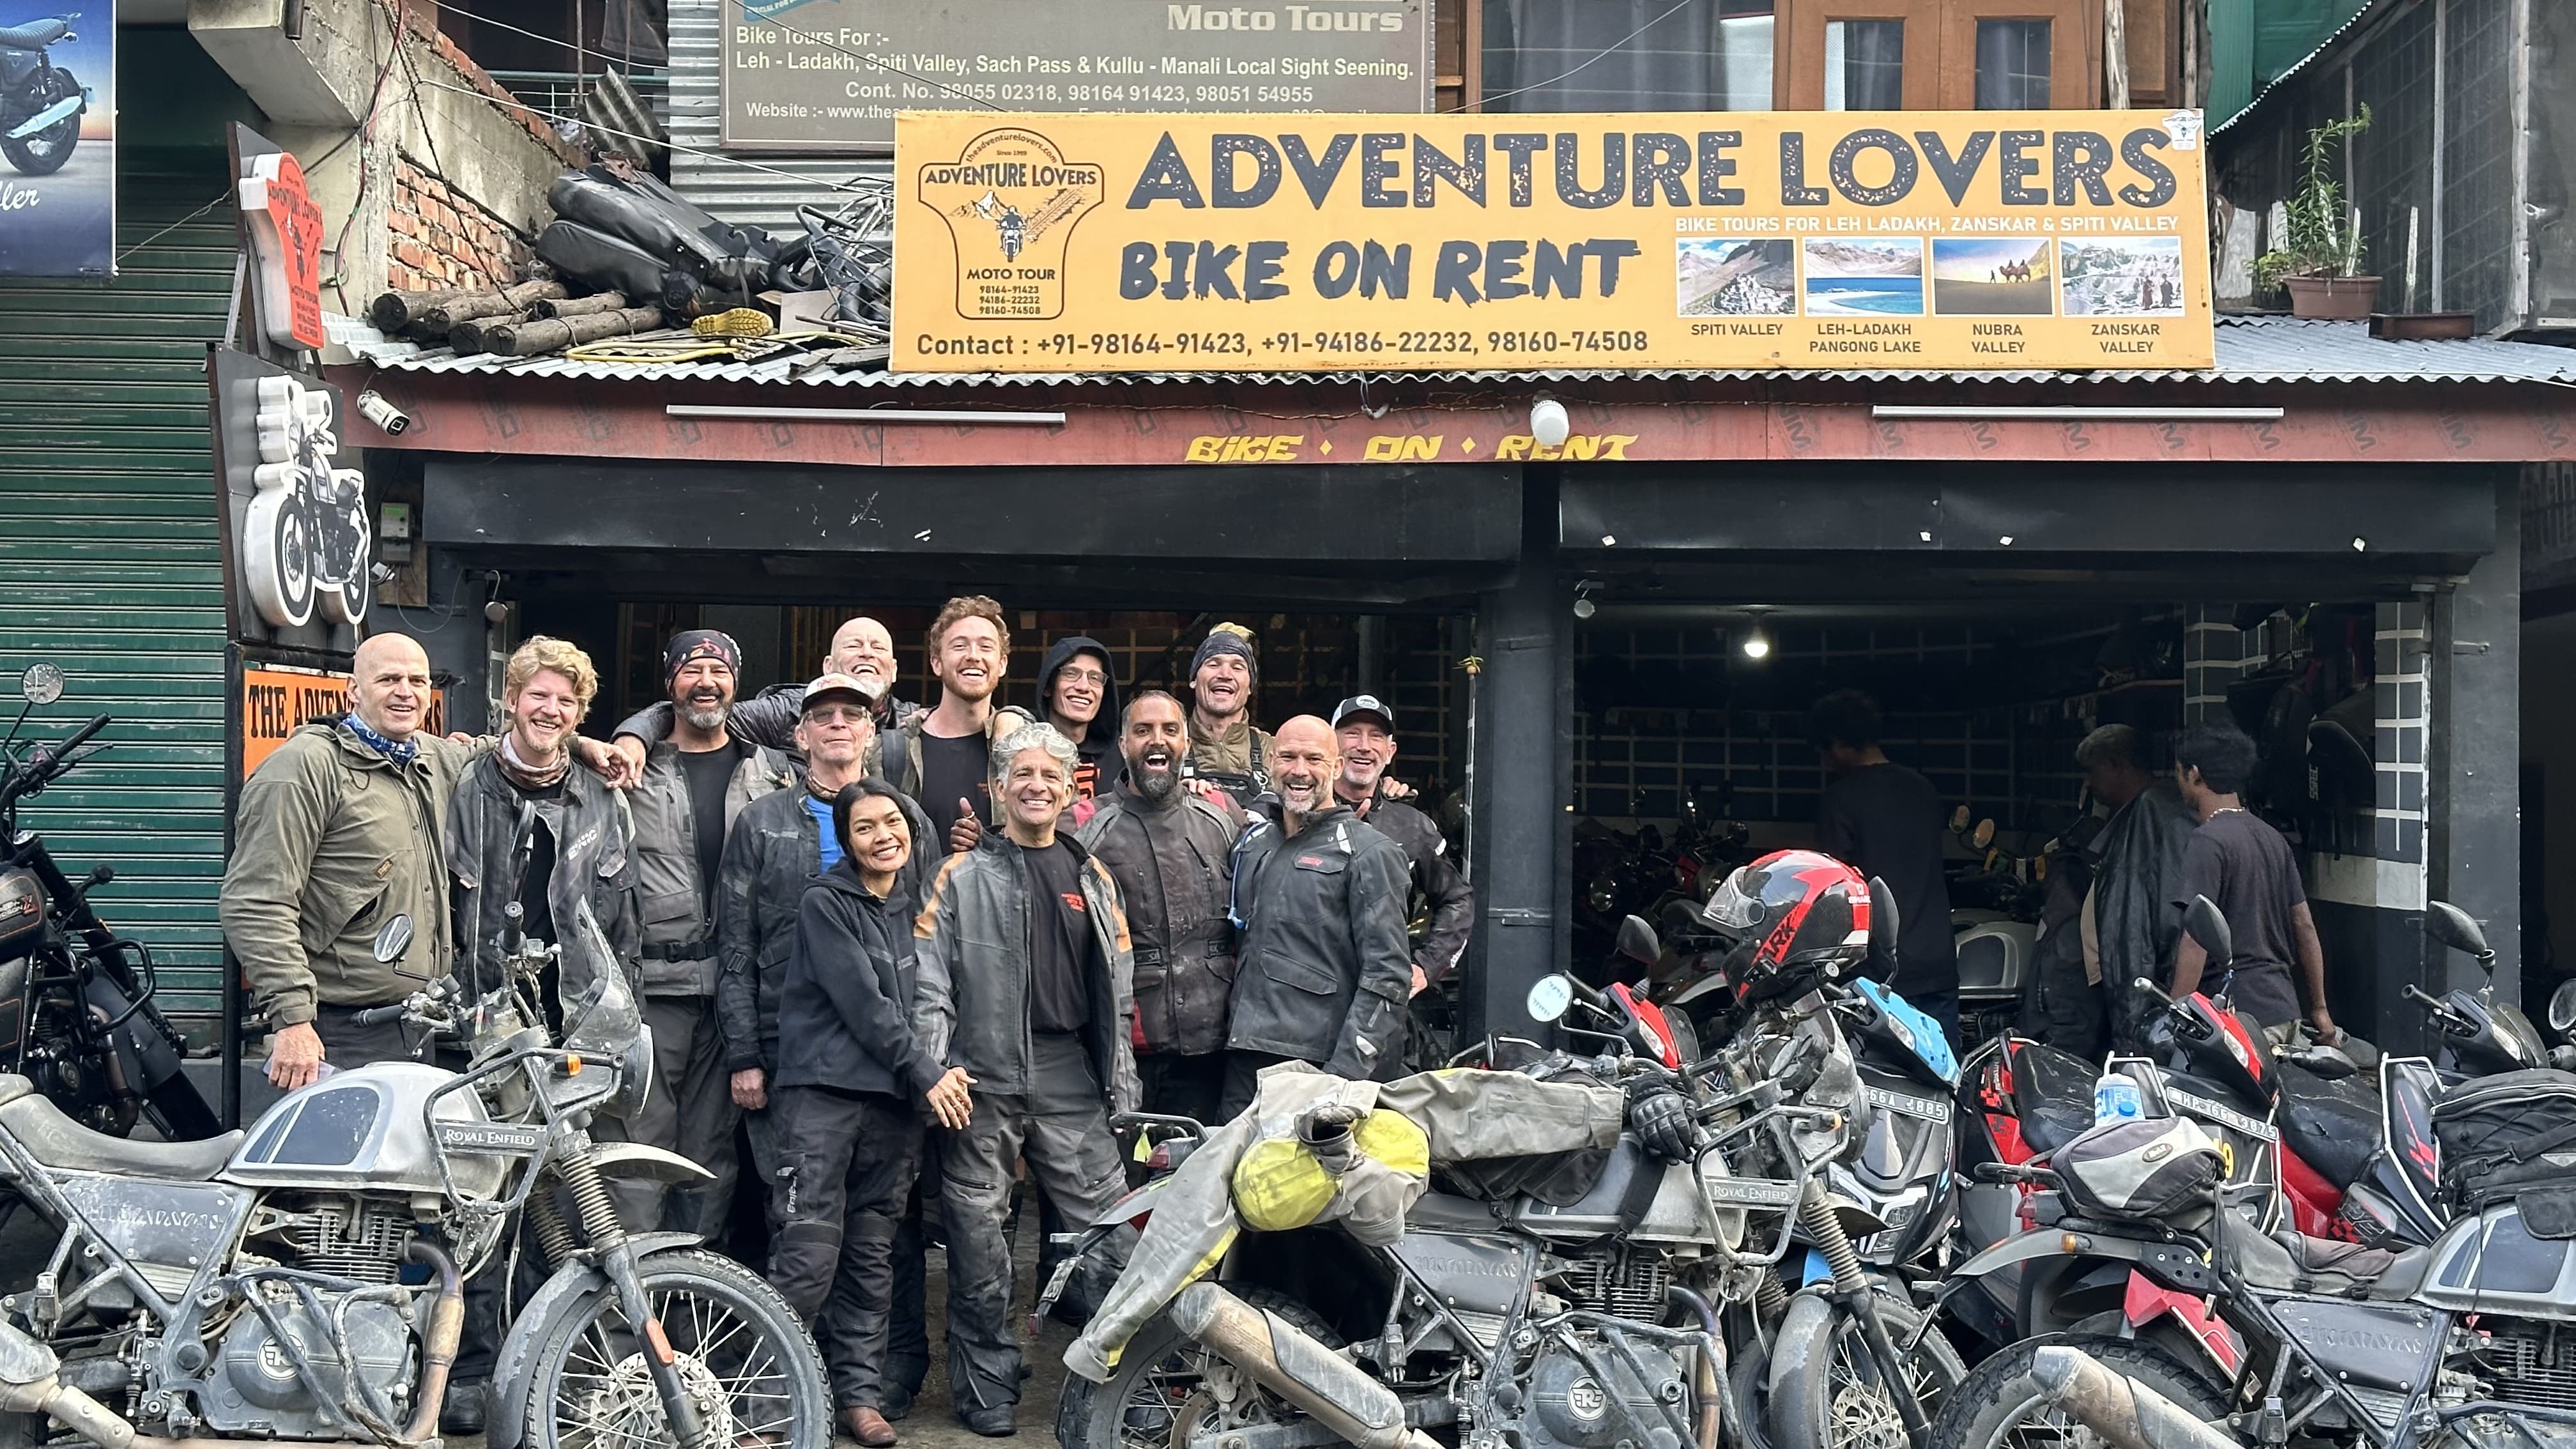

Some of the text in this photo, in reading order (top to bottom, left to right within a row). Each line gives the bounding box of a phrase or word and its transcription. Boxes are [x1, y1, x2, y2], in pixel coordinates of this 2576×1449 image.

[1168, 4, 1404, 32] Moto Tours
[736, 26, 776, 44] Bike
[782, 27, 834, 45] Tours
[839, 29, 871, 45] For
[736, 51, 770, 68] Leh
[788, 52, 860, 73] Ladakh,
[866, 53, 907, 75] Spiti
[912, 54, 970, 76] Valley,
[976, 55, 1022, 73] Sach
[1027, 56, 1071, 73] Pass
[1077, 56, 1091, 73] &
[1096, 56, 1144, 74] Kullu
[1162, 57, 1220, 75] Manali
[1226, 57, 1275, 75] Local
[1281, 58, 1330, 79] Sight
[1334, 58, 1414, 80] Seening.
[845, 81, 1314, 103] Cont. No. 98055 02318, 98164 91423, 98051 54955
[746, 102, 808, 118] Website
[925, 162, 1098, 188] ADVENTURE LOVERS
[1126, 128, 2177, 211] ADVENTURE LOVERS
[1676, 217, 2179, 234] BIKE TOURS FOR LEH LADAKH, ZANSKAR & SPITI VALLEY
[967, 268, 1055, 280] MOTO TOUR
[1119, 239, 1642, 307] BIKE ON RENT
[979, 286, 1039, 294] 98164-91423
[979, 296, 1040, 304] 94186-22232
[979, 306, 1041, 314] 98160-74508
[1691, 324, 1784, 336] SPITI VALLEY
[1817, 323, 1912, 336] LEH-LADAKH
[1972, 323, 2023, 336] NUBRA
[2091, 323, 2160, 336] ZANSKAR
[917, 334, 1014, 355] Contact
[1038, 333, 1254, 358] +91-98164-91423,
[1261, 332, 1479, 358] +91-94186-22232,
[1488, 332, 1648, 354] 98160-74508
[1809, 341, 1921, 353] PANGONG LAKE
[1972, 341, 2025, 354] VALLEY
[2099, 341, 2154, 354] VALLEY
[1363, 435, 1444, 461] ON
[249, 684, 350, 739] THE ADVEN
[445, 1128, 535, 1146] ROYAL ENFIELD
[1713, 1184, 1789, 1201] ROYAL ENFIELD
